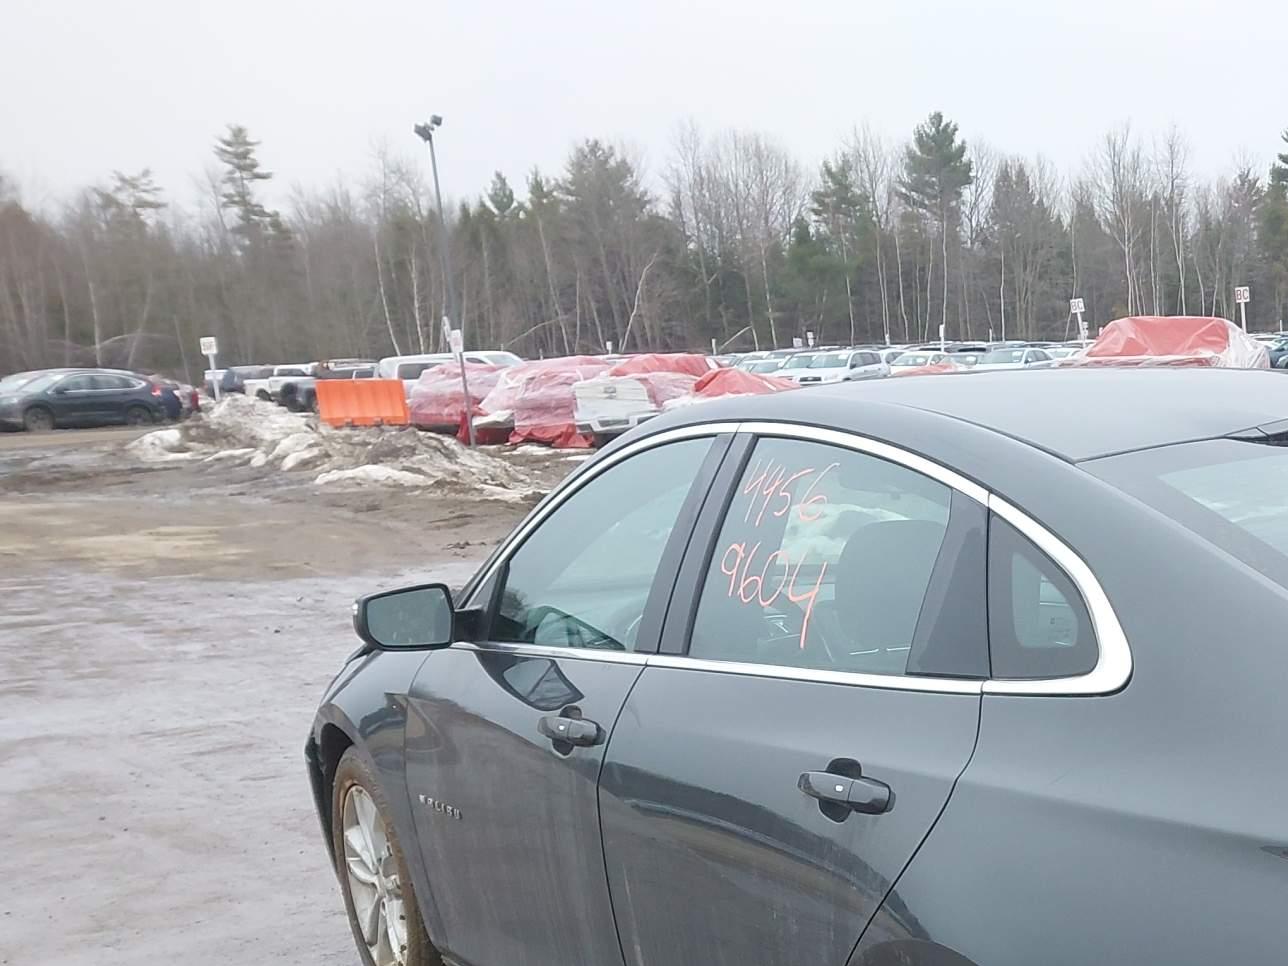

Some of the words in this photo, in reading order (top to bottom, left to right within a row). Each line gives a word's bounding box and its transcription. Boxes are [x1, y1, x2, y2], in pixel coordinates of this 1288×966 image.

[1071, 300, 1083, 312] BC
[1235, 288, 1249, 301] BC
[744, 458, 841, 527] 4456
[721, 542, 828, 650] 9604
